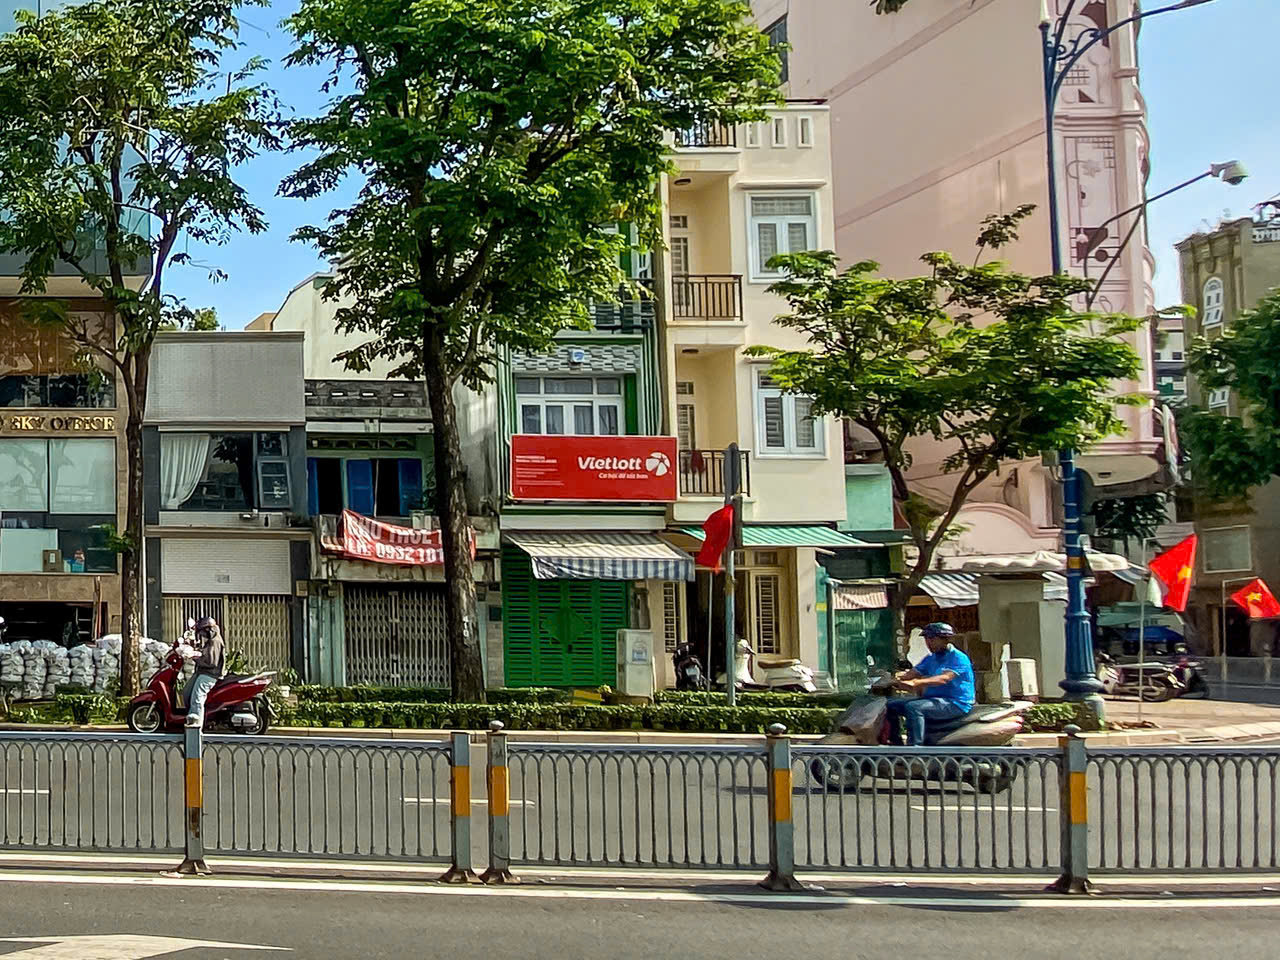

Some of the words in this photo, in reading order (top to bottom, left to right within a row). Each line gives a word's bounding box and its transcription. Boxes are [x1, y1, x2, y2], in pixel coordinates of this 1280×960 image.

[11, 416, 45, 431] SKY
[50, 416, 115, 431] OFFICE
[578, 456, 642, 471] Vietlott
